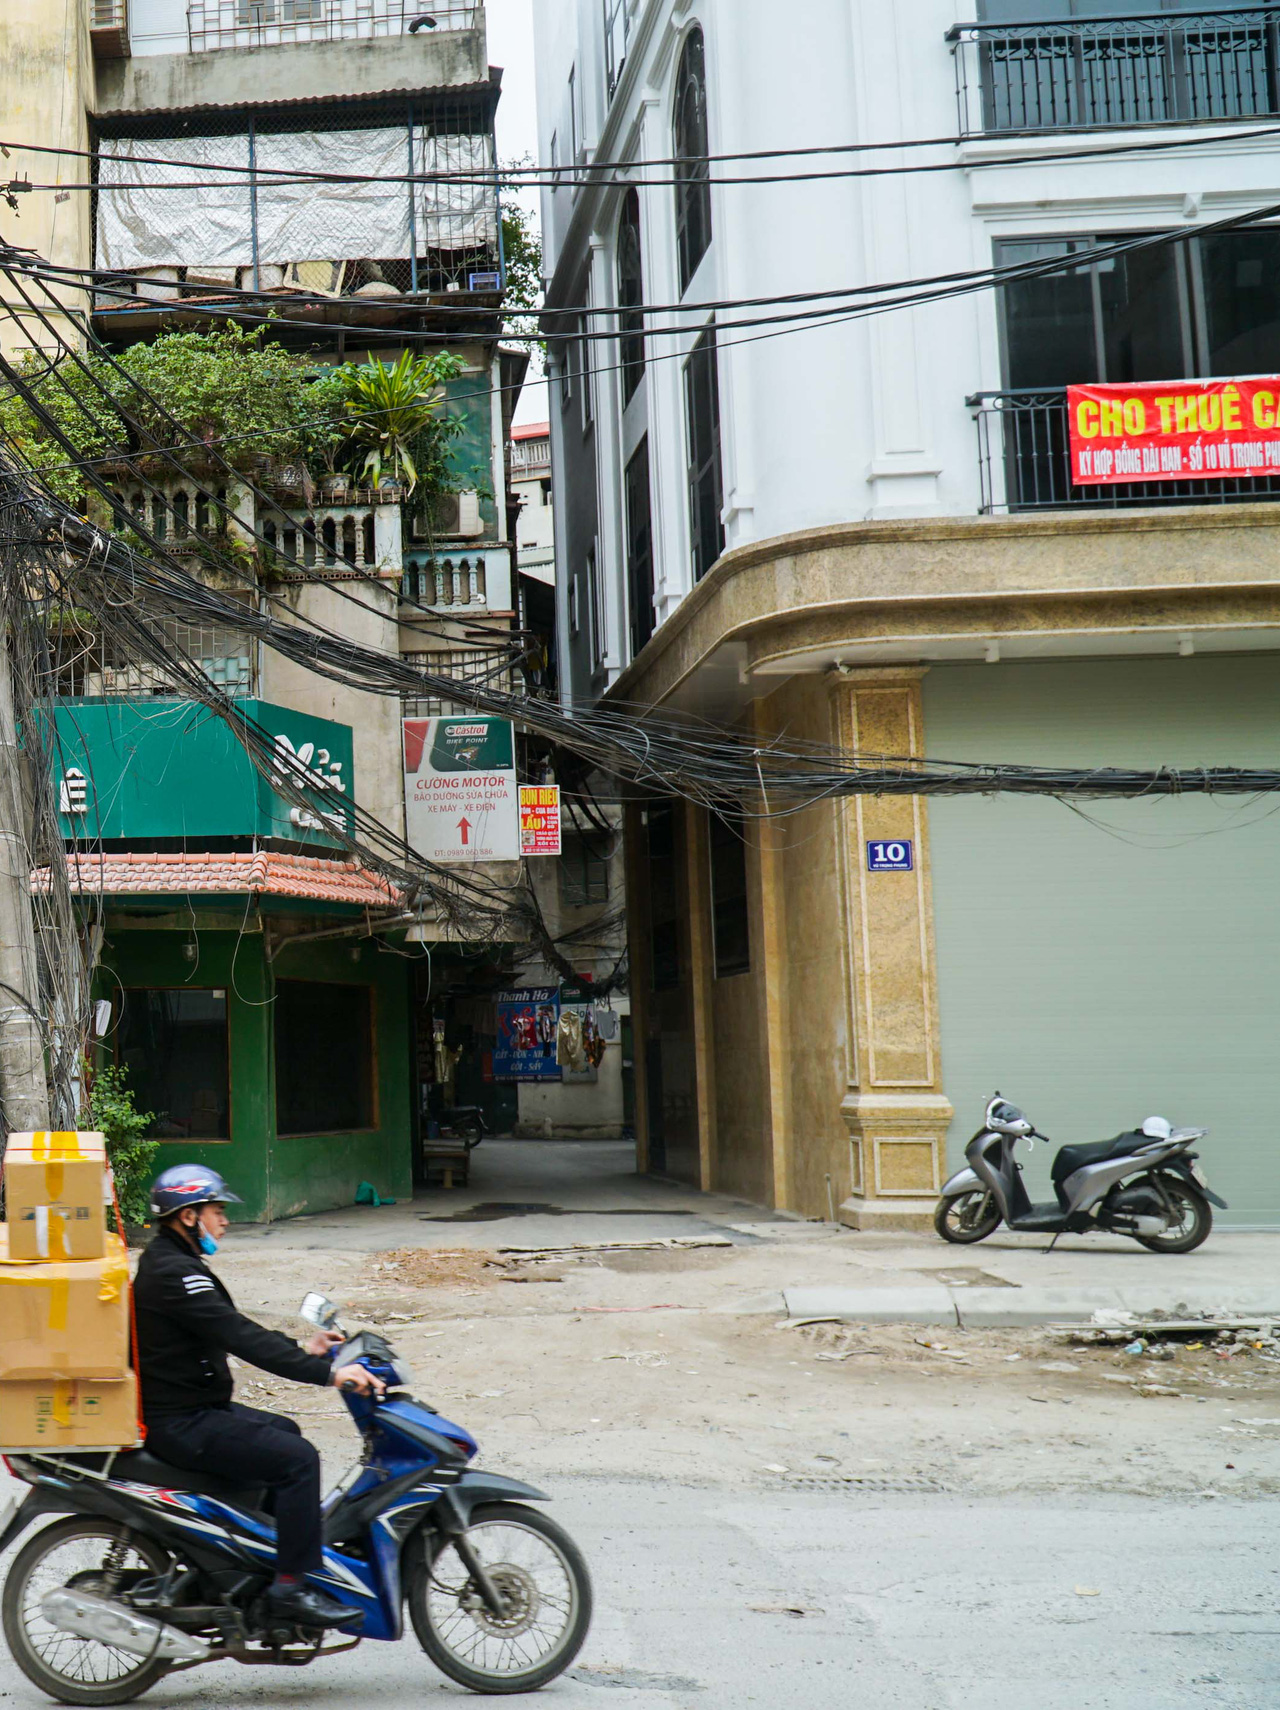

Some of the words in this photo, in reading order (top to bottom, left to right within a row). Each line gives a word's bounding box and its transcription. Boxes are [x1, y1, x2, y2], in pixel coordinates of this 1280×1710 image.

[1076, 398, 1145, 438] CHO
[1155, 384, 1242, 434] THUÊ
[1161, 446, 1182, 477] HẠN
[1189, 436, 1203, 471] SỐ
[1204, 443, 1218, 470] 10
[1231, 441, 1264, 478] TRỌNG
[455, 726, 485, 735] Castrol
[416, 777, 459, 790] CƯỜNG
[462, 776, 505, 788] MOTOR
[464, 804, 474, 812] XE
[874, 843, 905, 862] 10
